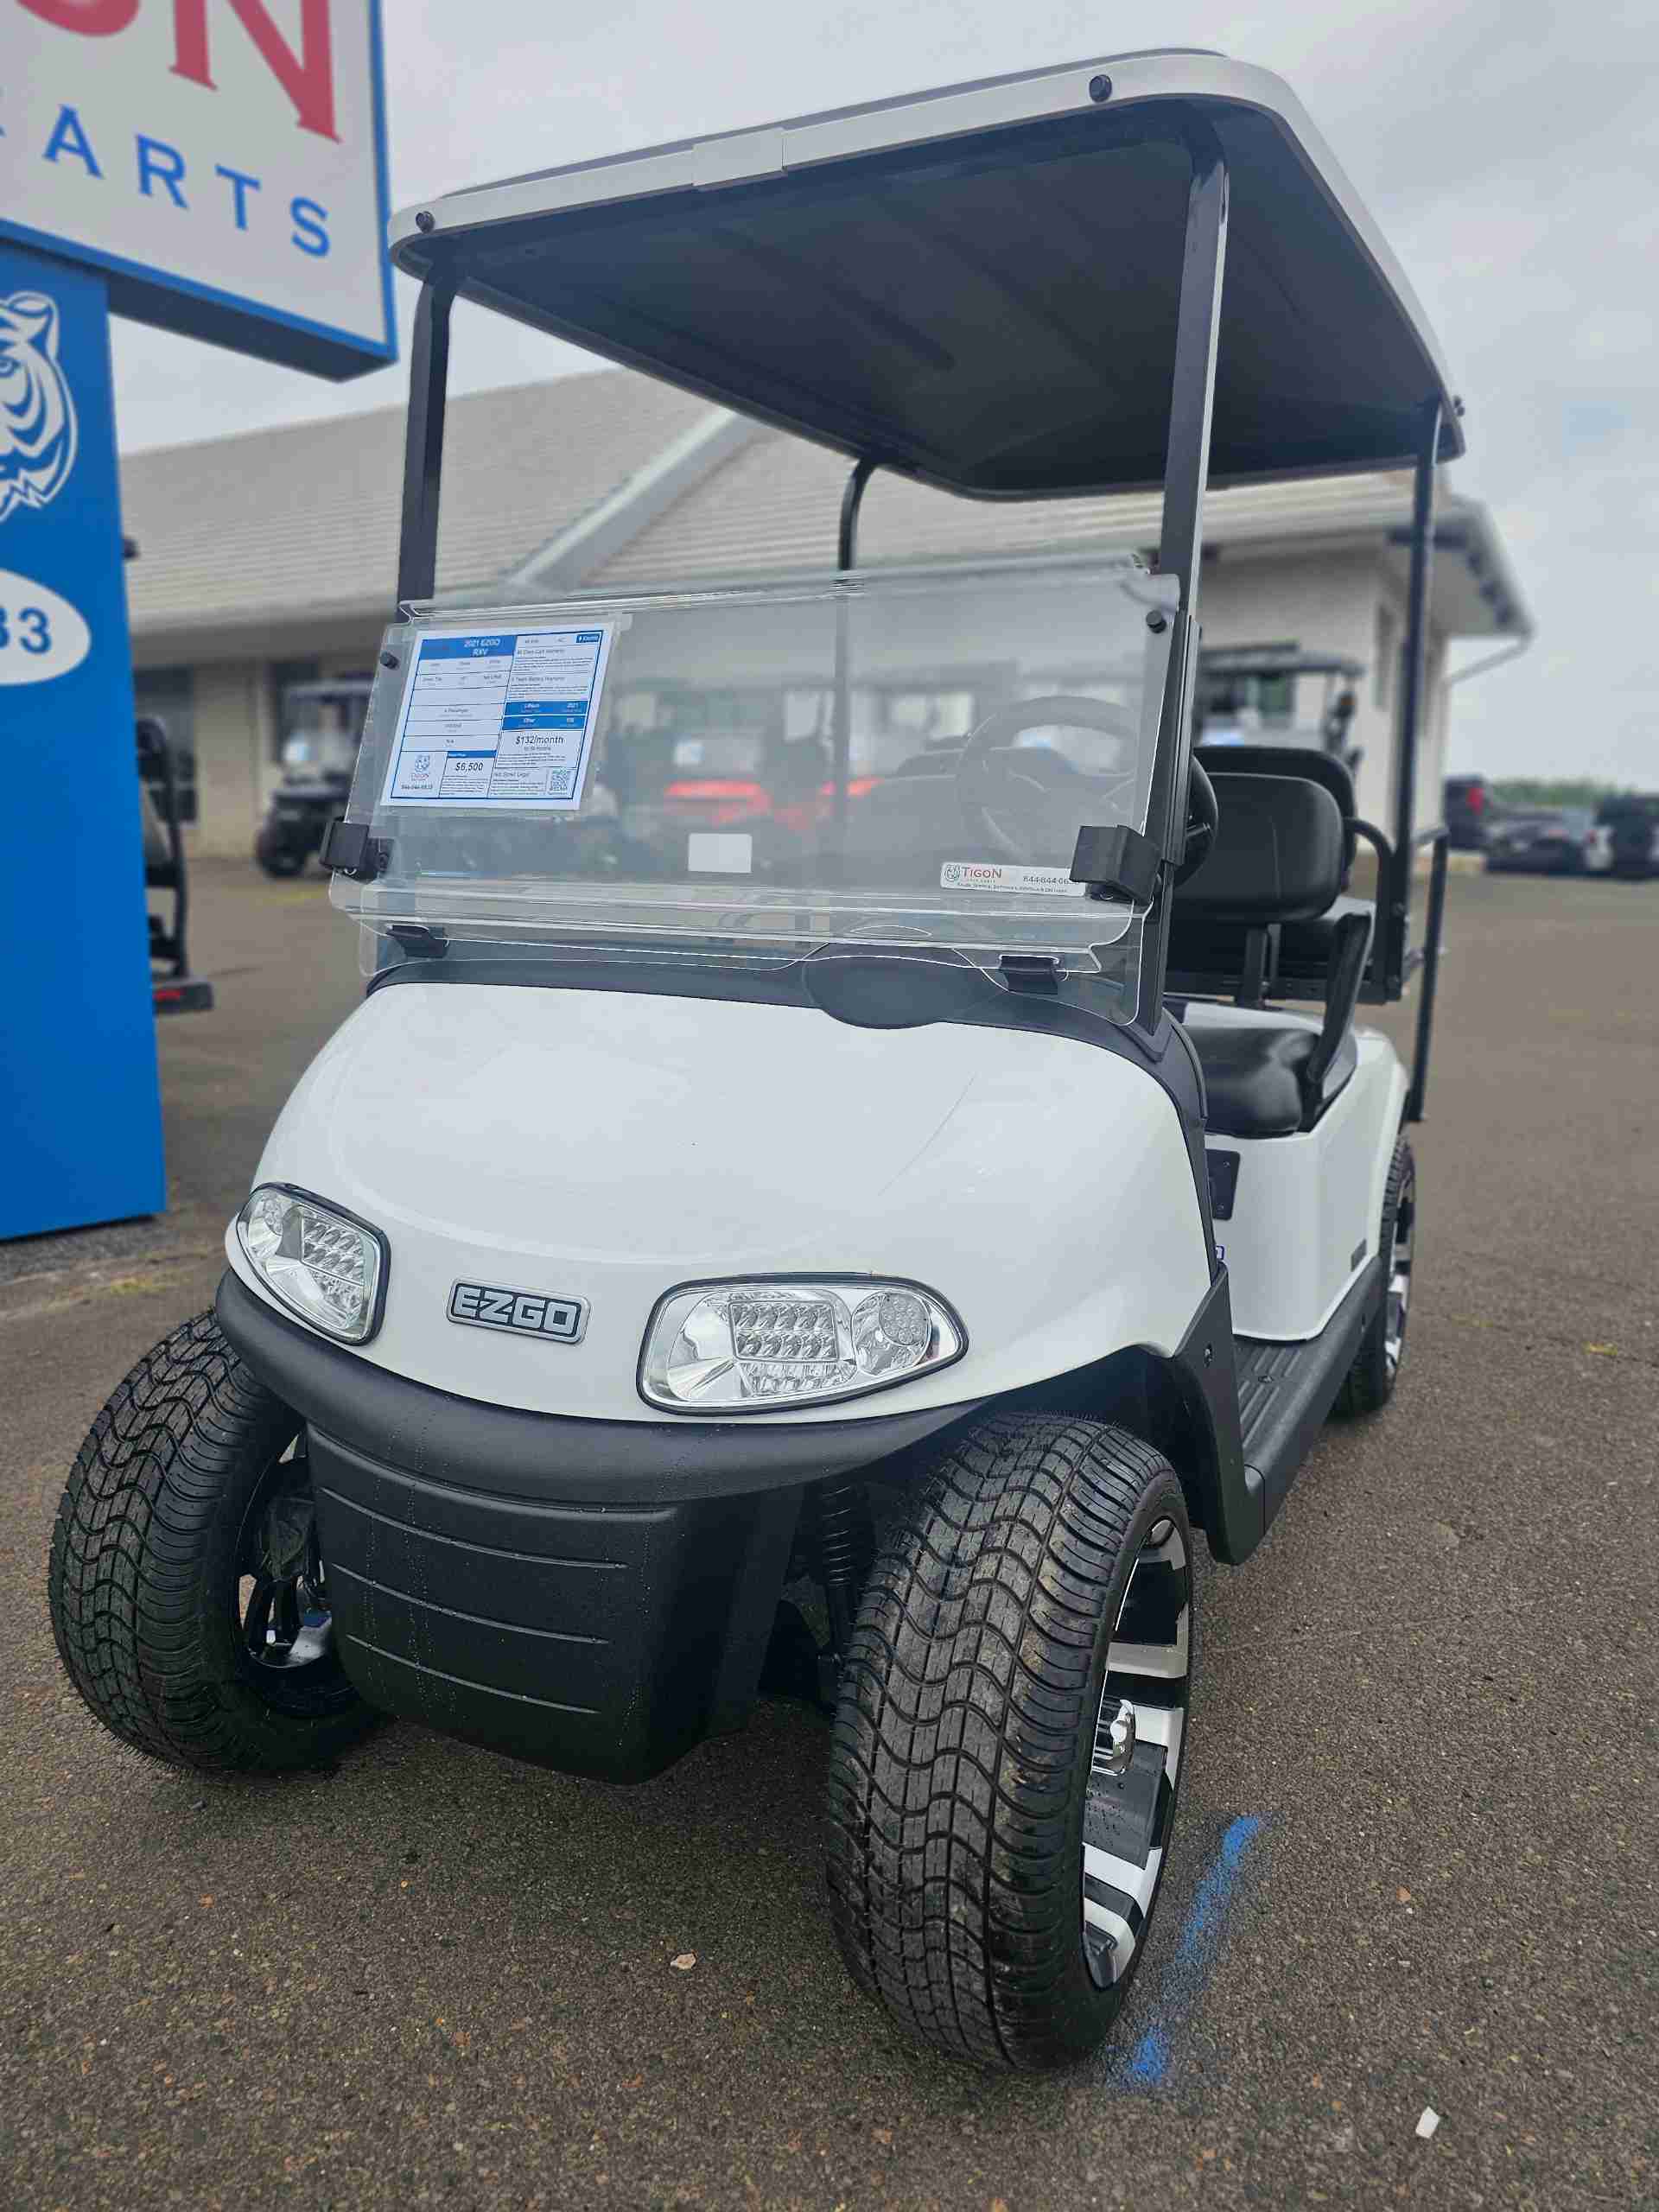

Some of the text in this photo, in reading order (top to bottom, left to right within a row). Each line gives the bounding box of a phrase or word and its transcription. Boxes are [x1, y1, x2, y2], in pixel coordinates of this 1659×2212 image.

[0, 104, 332, 258] ARTS
[516, 734, 564, 745] $132/month
[455, 762, 484, 772] $6,500
[962, 867, 1002, 879] TIGON
[454, 1286, 577, 1335] EZGO
